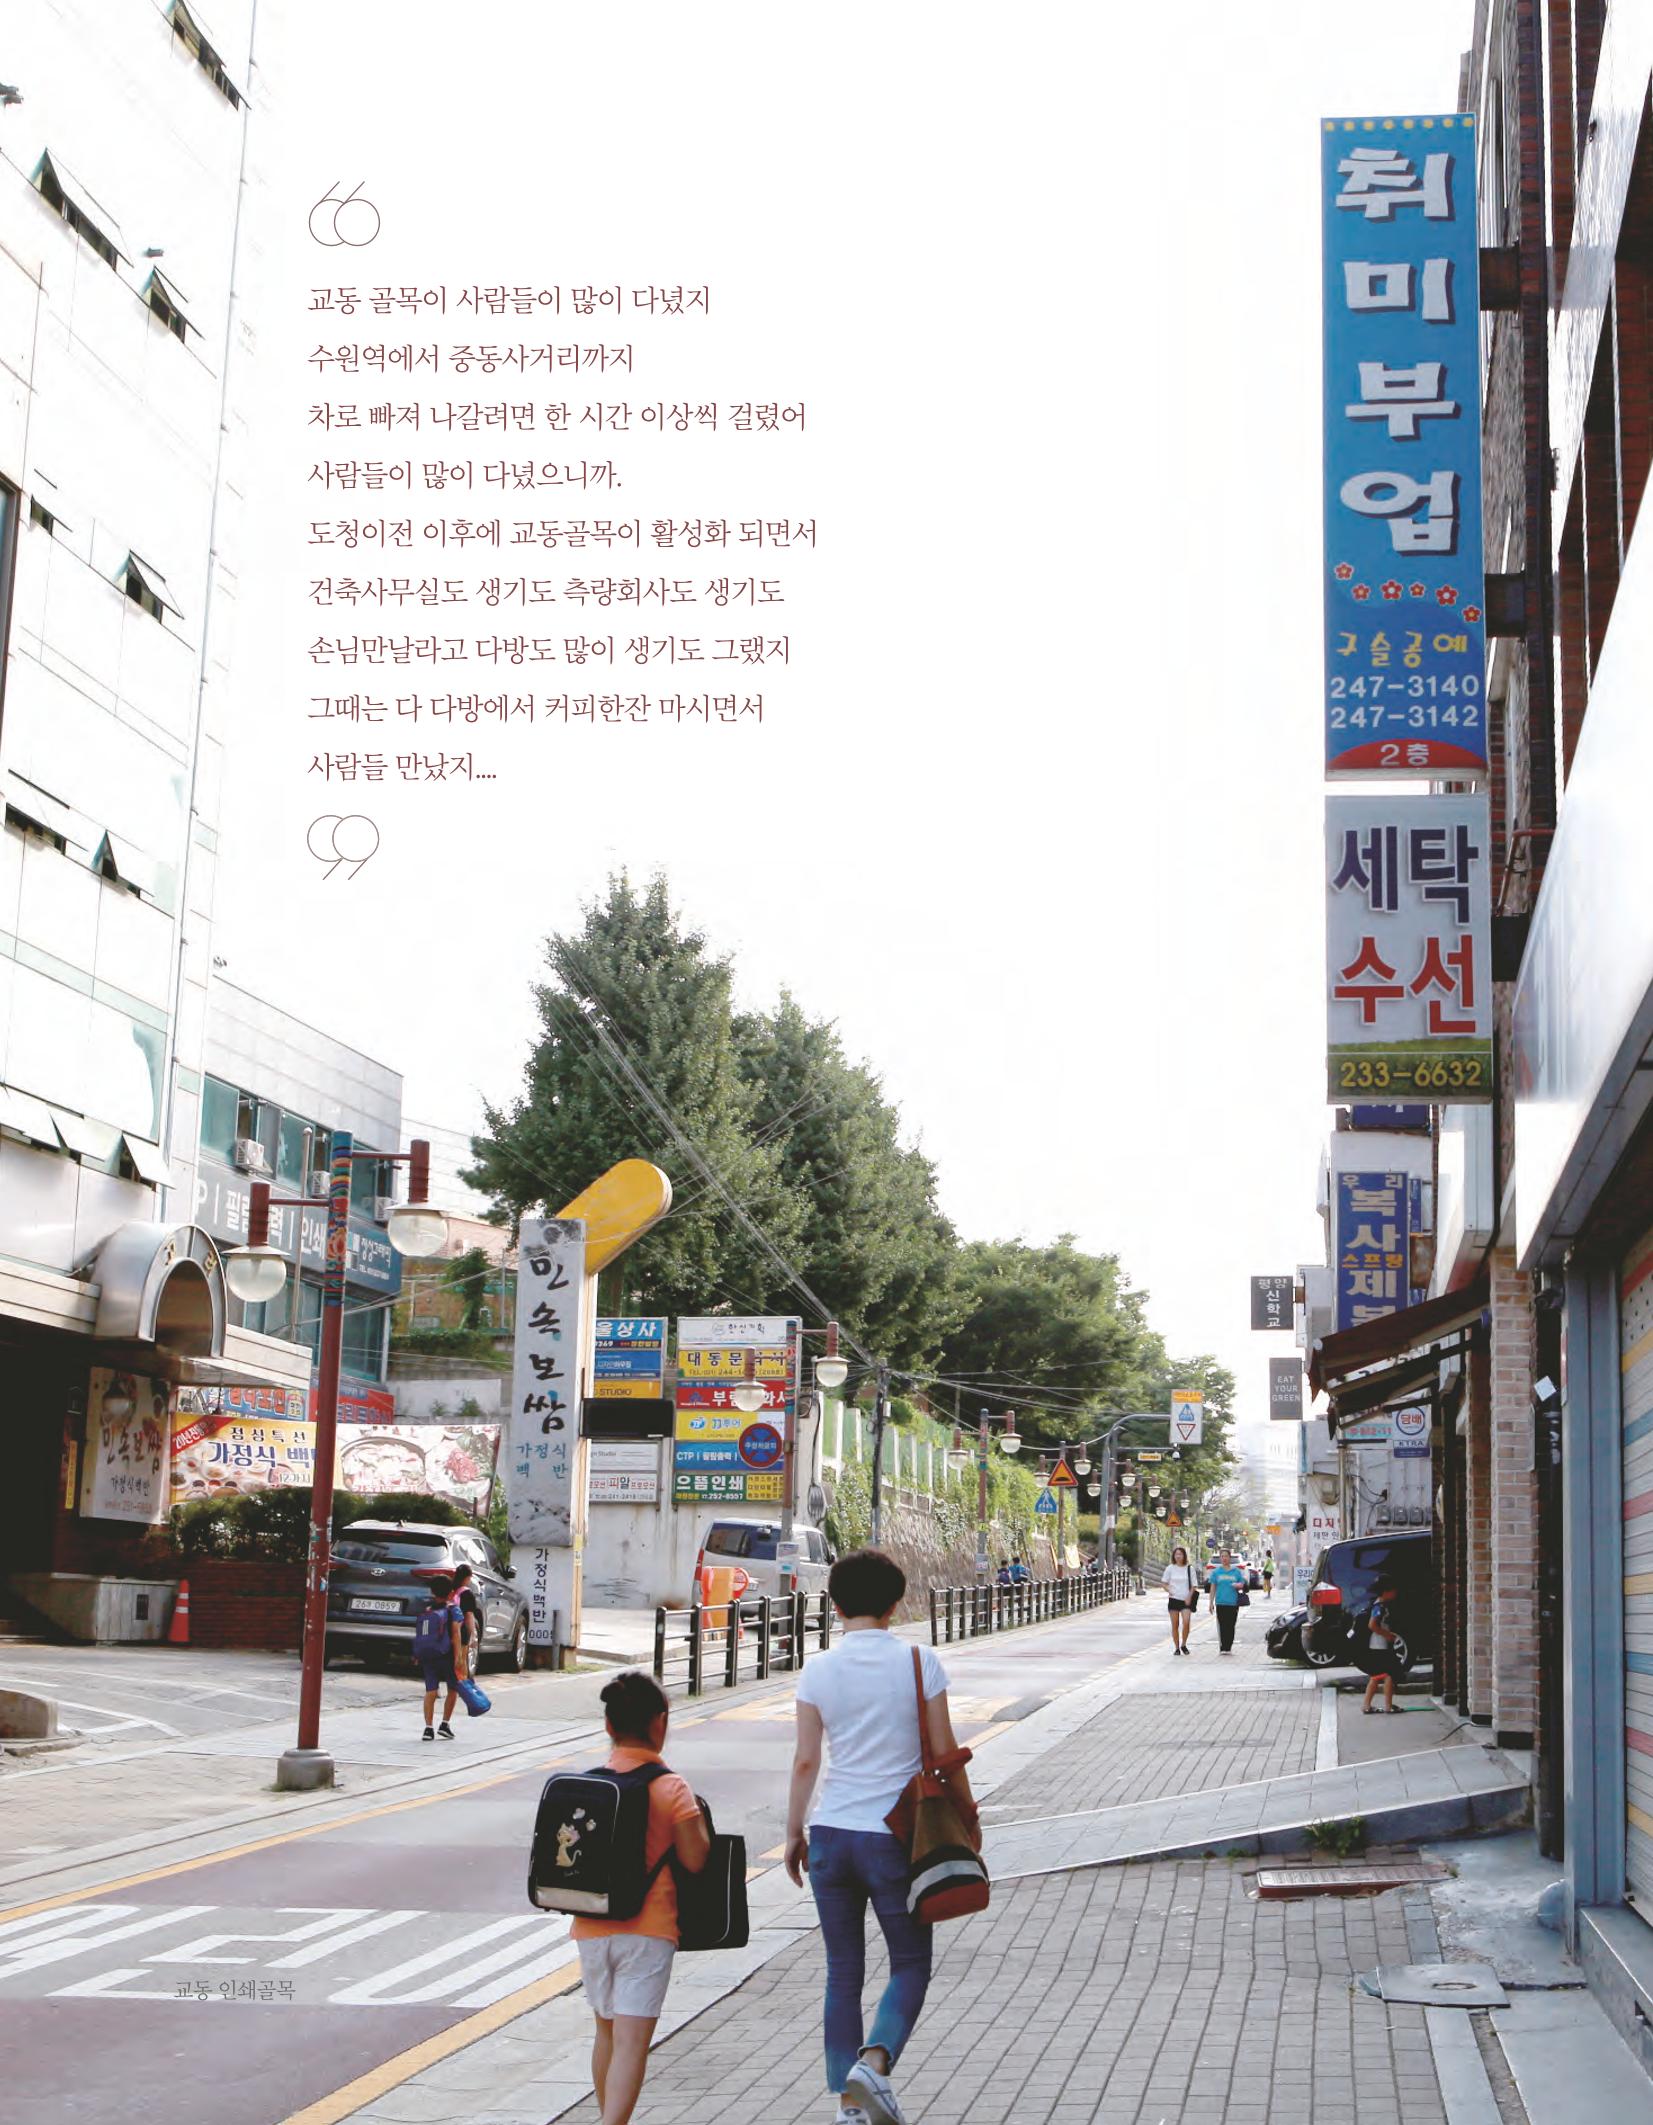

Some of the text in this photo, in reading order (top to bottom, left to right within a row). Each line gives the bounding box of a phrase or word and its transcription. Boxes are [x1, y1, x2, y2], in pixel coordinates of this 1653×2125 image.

[1335, 147, 1458, 554] 취미부업
[1336, 631, 1467, 668] 구슬공예
[1330, 675, 1480, 698] 247-3140
[1330, 705, 1480, 728] 247-3142
[1333, 825, 1479, 924] 세탁
[1334, 934, 1476, 1034] 수선
[1340, 1062, 1481, 1087] 233-6632
[1342, 1174, 1403, 1189] 우리
[1342, 1253, 1403, 1268] 스프링
[523, 1255, 569, 1434] 민속보쌈
[1400, 1413, 1422, 1425] 담배
[208, 1442, 276, 1468] 가정식
[516, 1444, 567, 1459] 가정식
[676, 1451, 694, 1460] CTP
[676, 1474, 744, 1491] 으뜸인쇄
[532, 1548, 549, 1623] 가정식백반
